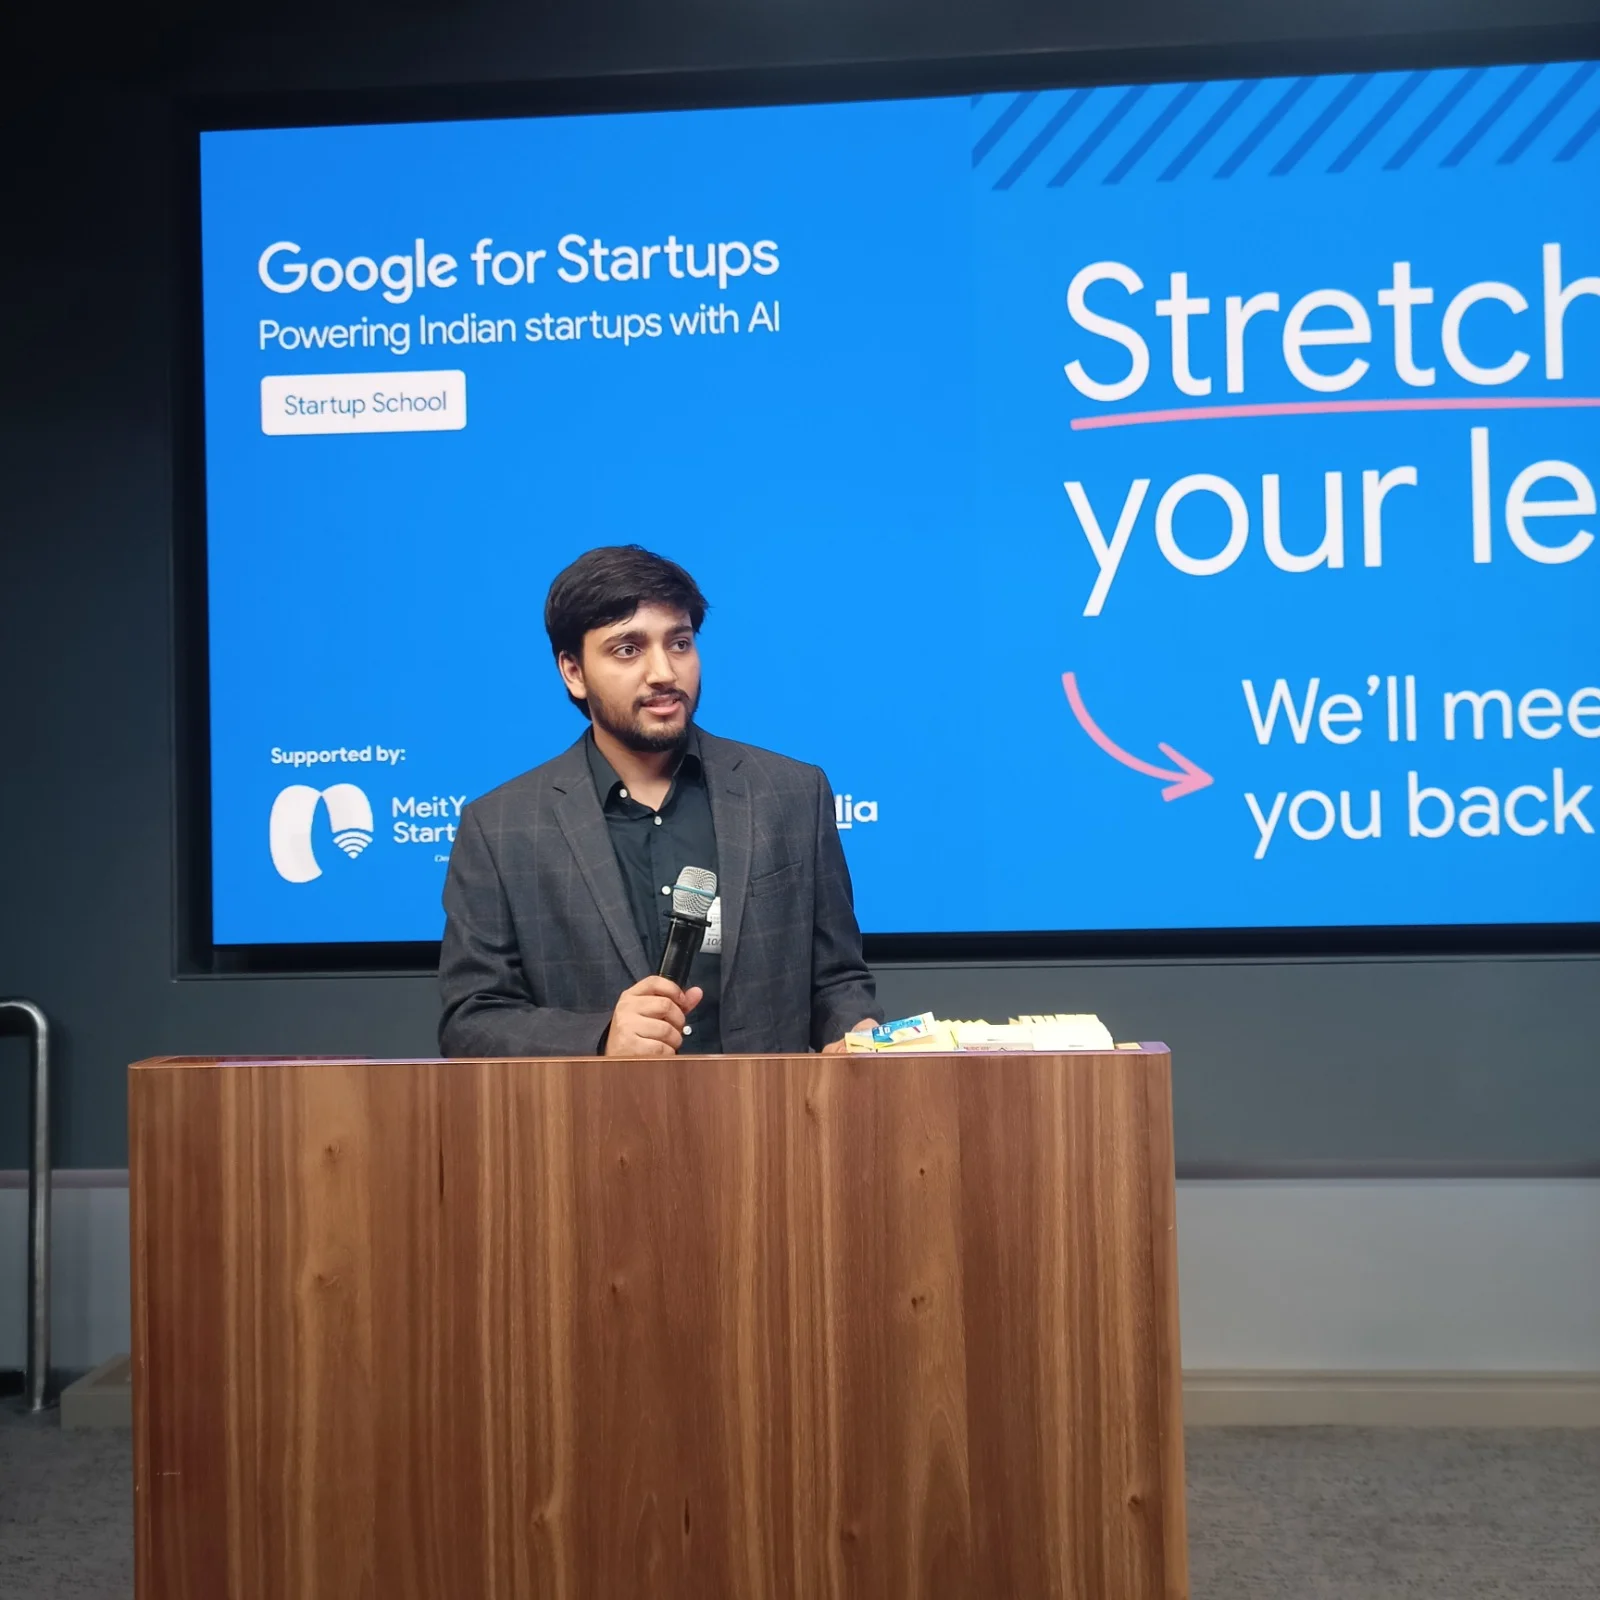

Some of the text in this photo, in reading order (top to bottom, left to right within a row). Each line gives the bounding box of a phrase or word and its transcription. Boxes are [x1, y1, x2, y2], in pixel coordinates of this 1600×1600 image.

[258, 234, 780, 304] Google for Startups
[259, 301, 780, 355] Powering Indian startups with AI
[1063, 242, 1600, 402] Stretch
[284, 391, 447, 418] Startup School
[1063, 427, 1597, 617] your le
[1241, 675, 1600, 745] We'll mee
[271, 745, 406, 768] Supported by:
[392, 795, 467, 818] MeitY
[393, 821, 457, 843] Start
[1244, 768, 1595, 860] you back
